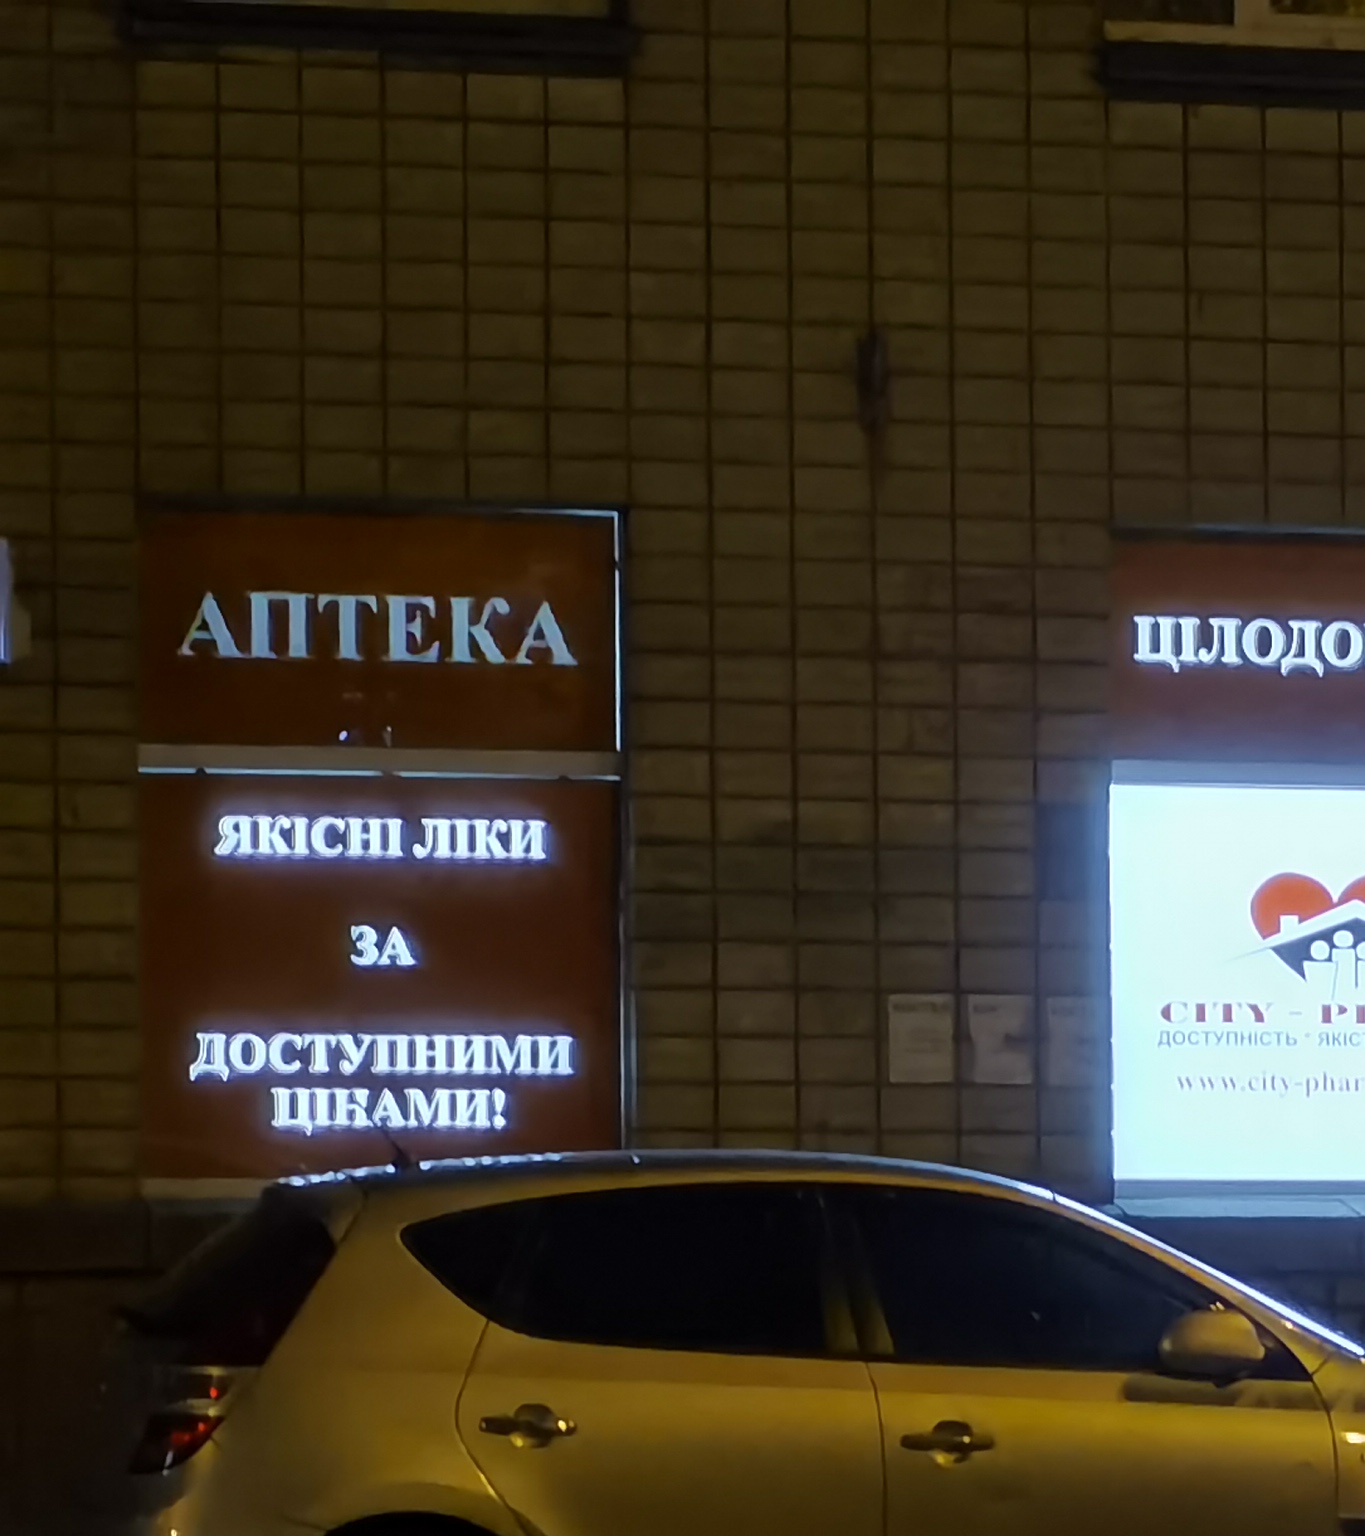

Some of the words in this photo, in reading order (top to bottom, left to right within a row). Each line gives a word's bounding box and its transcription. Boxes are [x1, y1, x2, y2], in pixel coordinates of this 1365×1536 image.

[178, 591, 578, 666] АПТЕКА
[213, 814, 405, 859] ЯКІСНІ
[412, 818, 548, 860] ЛІКИ
[350, 924, 417, 966] ЗА
[1160, 1001, 1274, 1024] CITY
[189, 1032, 575, 1081] ДОСТУПНИМИ
[1157, 1029, 1298, 1048] ДОСТУПНІСТЬ
